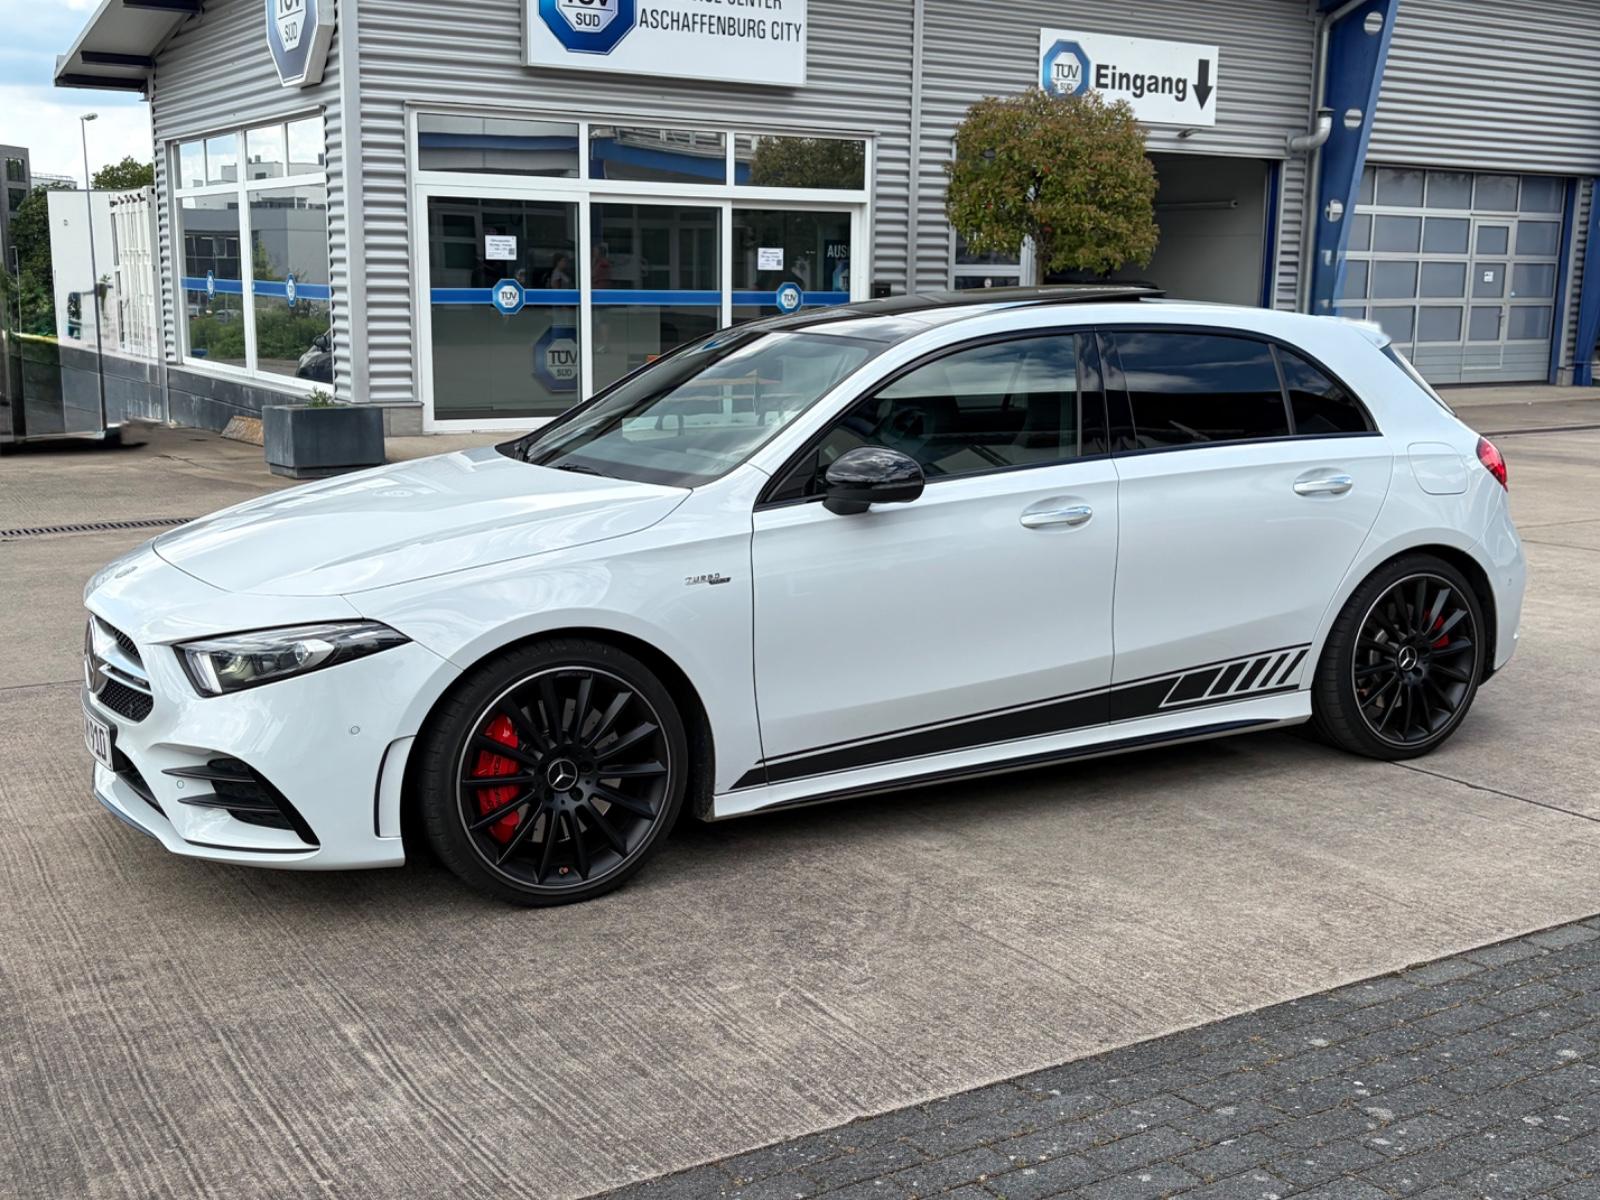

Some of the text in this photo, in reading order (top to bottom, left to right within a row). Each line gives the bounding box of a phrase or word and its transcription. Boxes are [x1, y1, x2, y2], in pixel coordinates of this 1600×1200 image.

[575, 12, 601, 27] SÜD
[639, 8, 801, 42] ASCHAFFENBURG CITY
[1054, 63, 1080, 79] TÜV
[1095, 64, 1188, 102] Eingang
